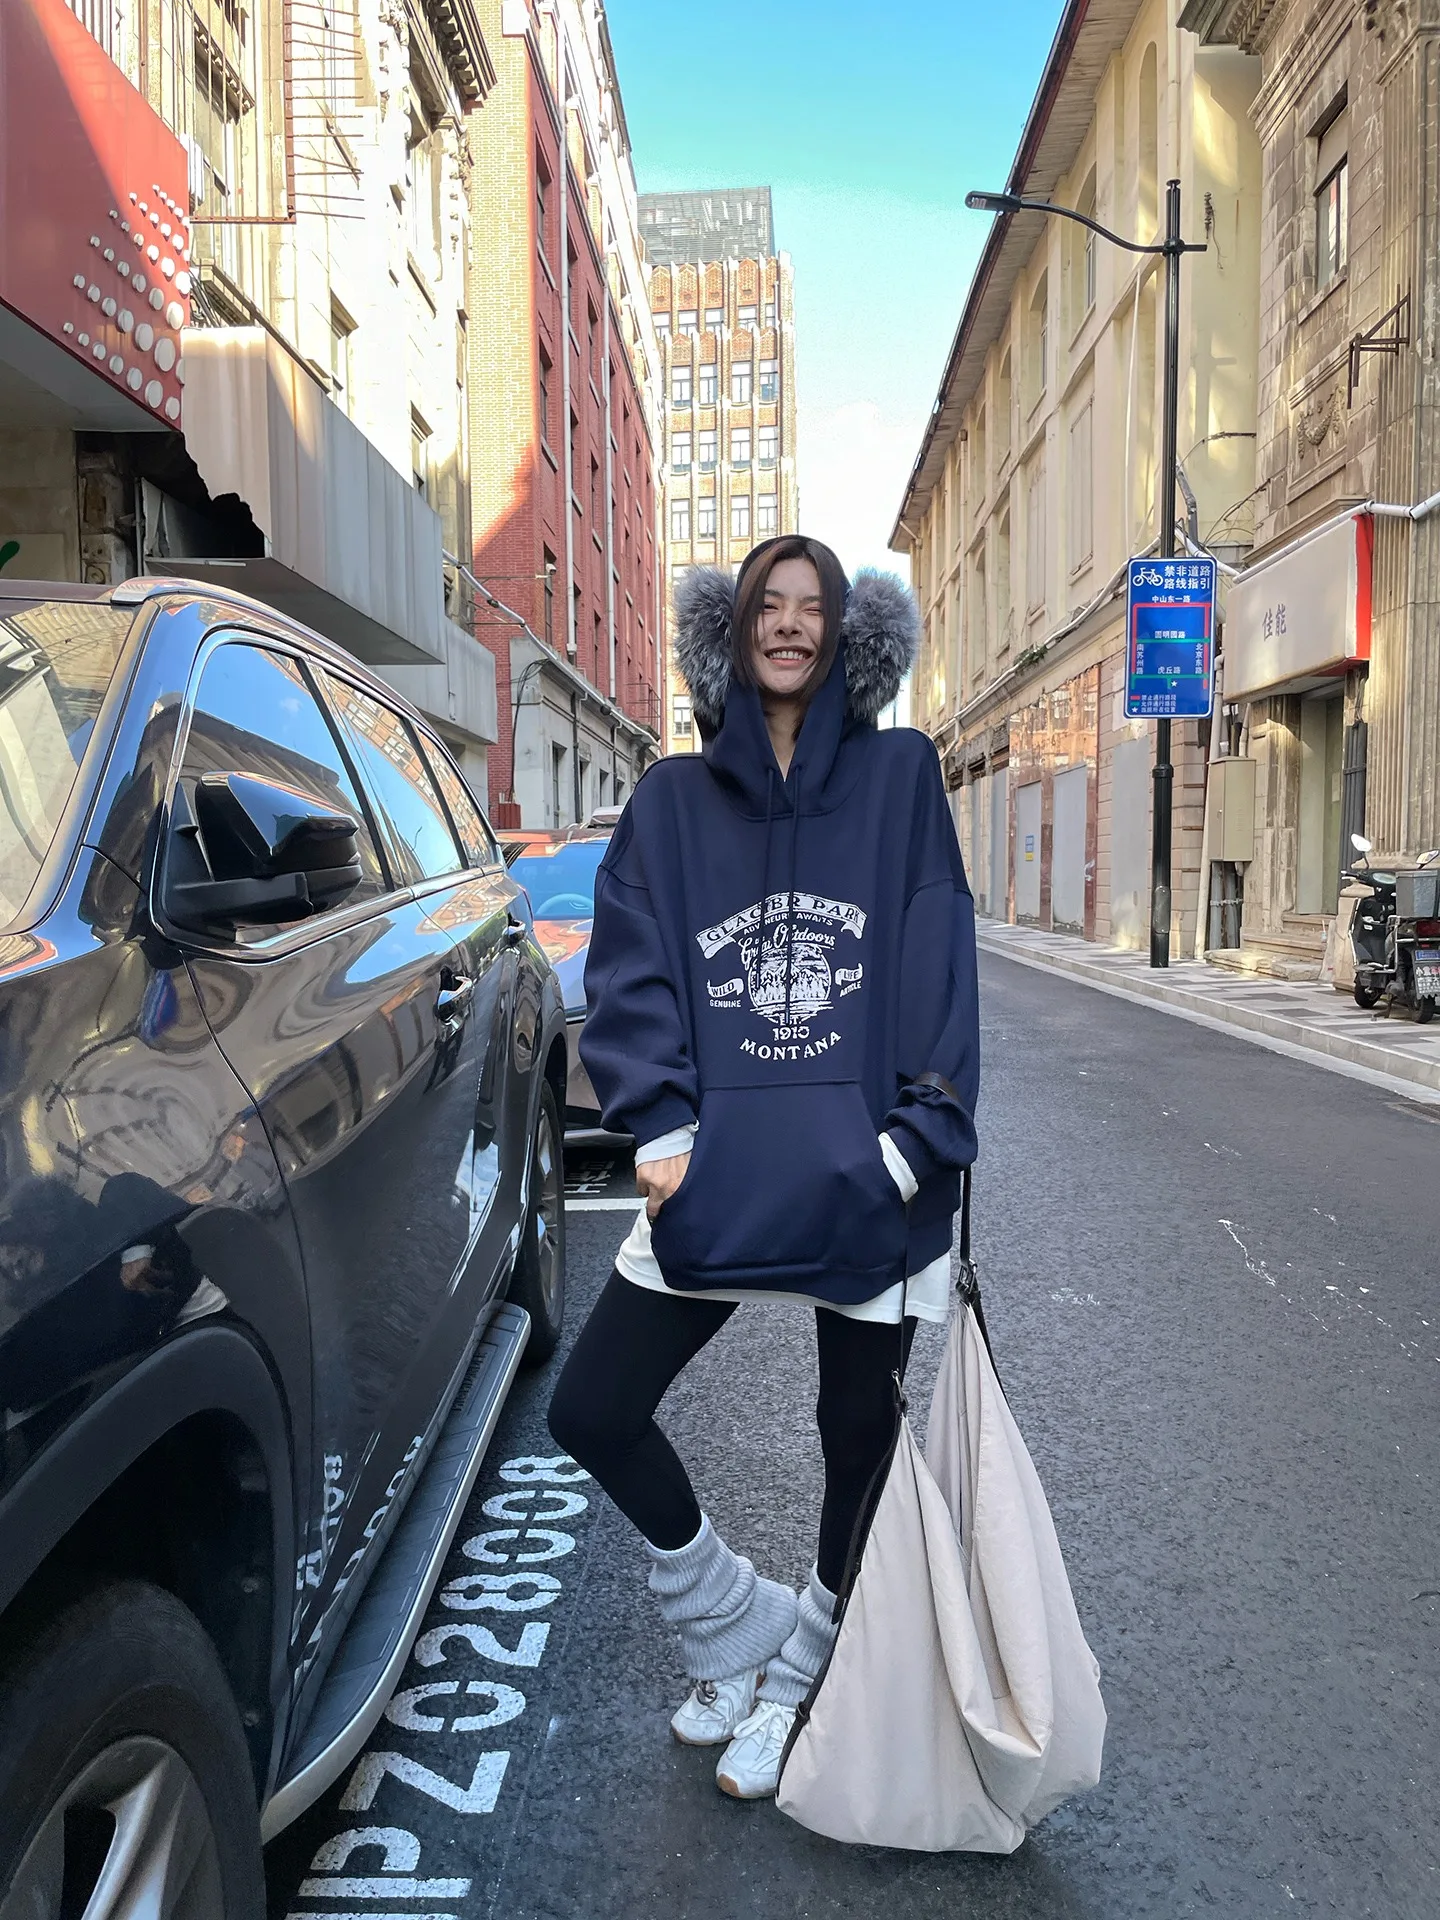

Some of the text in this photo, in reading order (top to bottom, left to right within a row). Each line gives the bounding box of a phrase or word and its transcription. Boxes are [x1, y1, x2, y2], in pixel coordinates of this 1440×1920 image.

[1164, 565, 1211, 577] 禁非道路
[1163, 577, 1210, 590] 路线指引
[1151, 595, 1191, 603] 中山东一路
[1195, 643, 1203, 675] 北京东路
[1157, 666, 1181, 674] 虎丘路
[812, 898, 860, 923] PARK
[796, 912, 833, 926] AWAITS
[843, 970, 859, 980] LIFE
[711, 981, 735, 997] WILD
[709, 999, 742, 1008] GENUINE
[772, 1025, 810, 1041] 1910
[739, 1031, 842, 1060] MONTANA
